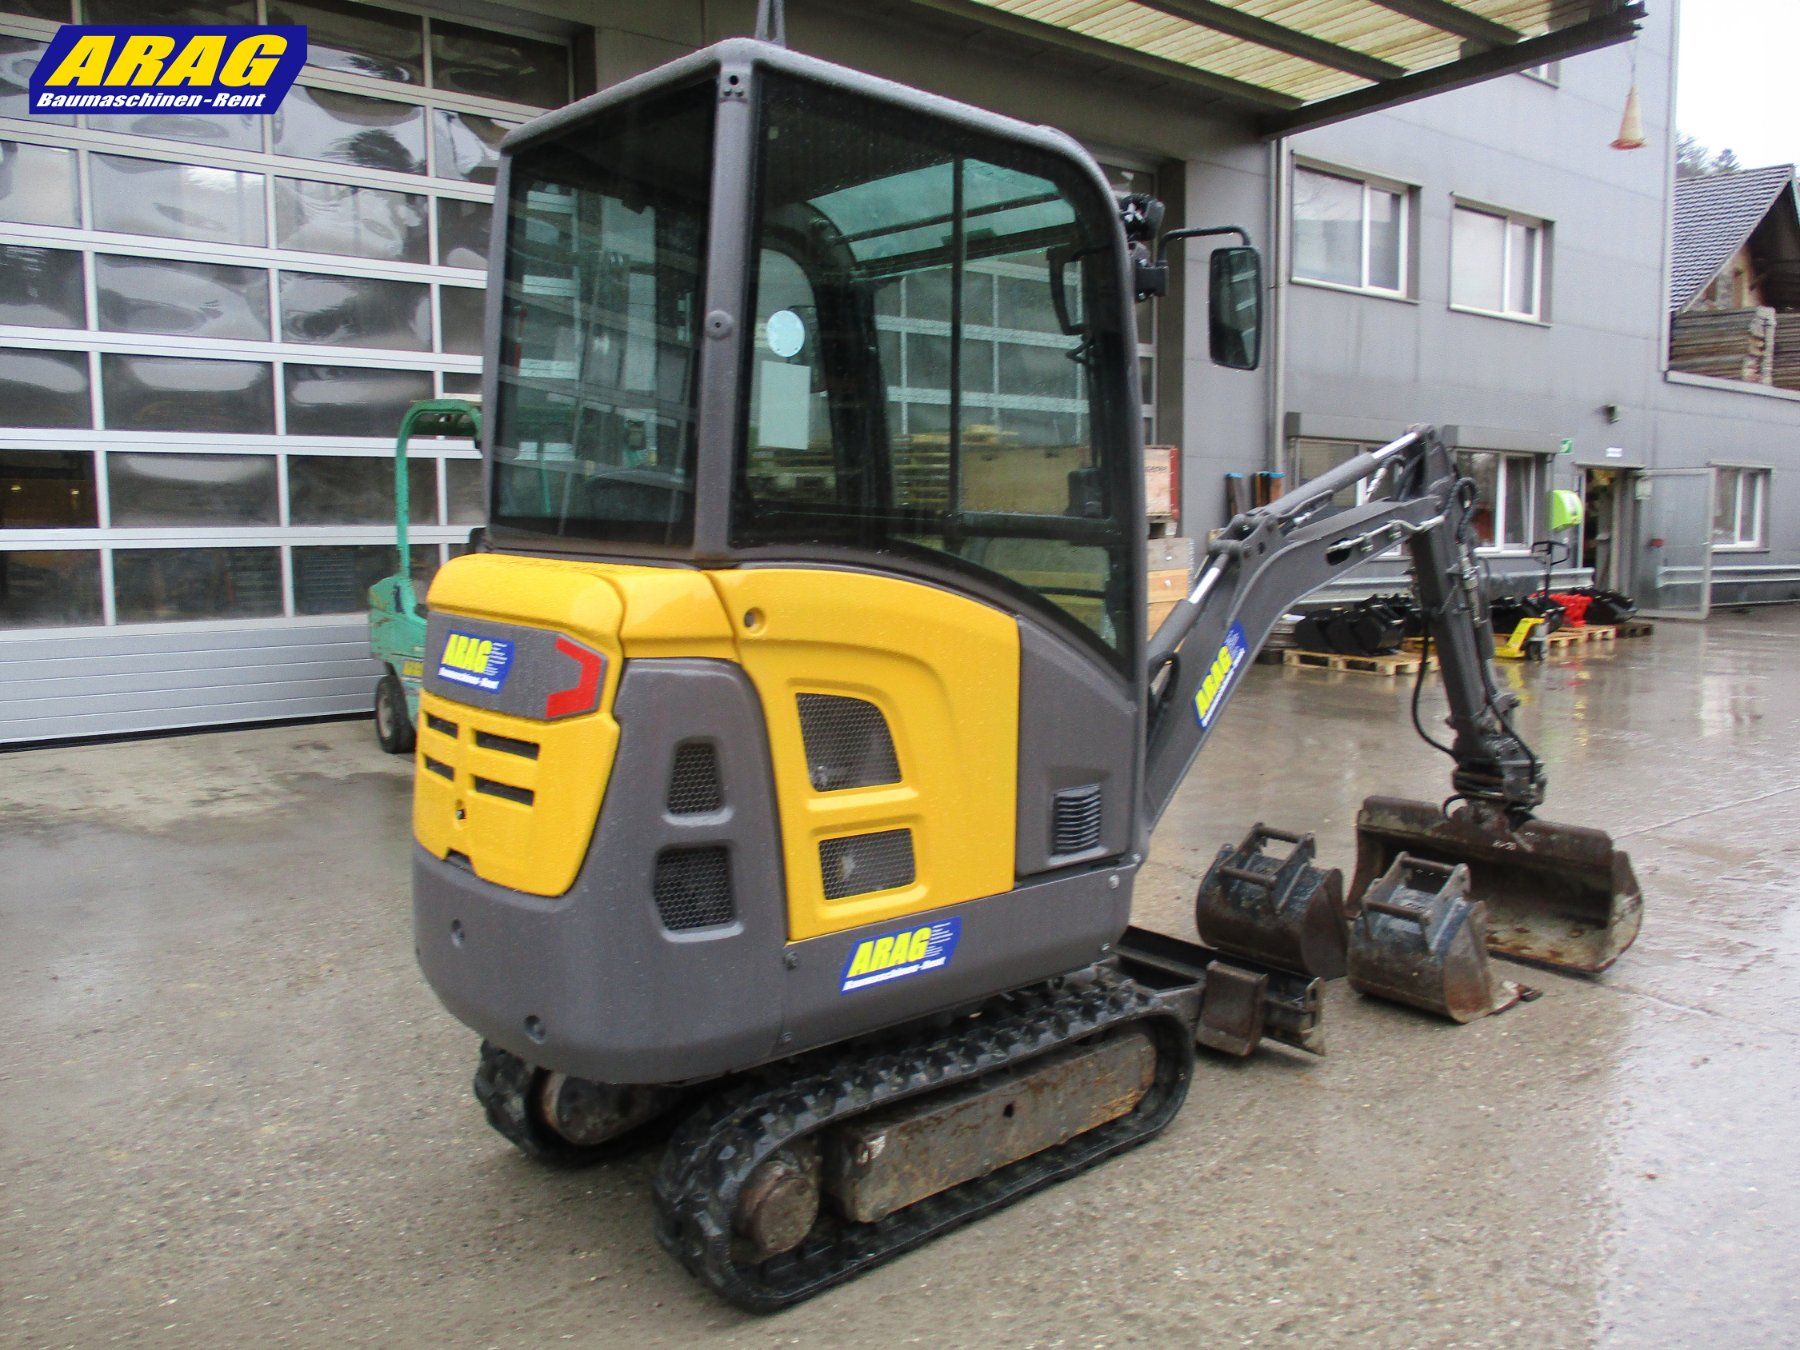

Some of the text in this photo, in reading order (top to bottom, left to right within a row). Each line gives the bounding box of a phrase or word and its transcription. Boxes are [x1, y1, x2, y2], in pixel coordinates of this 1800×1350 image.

[441, 634, 493, 674] ARAG
[1195, 645, 1232, 719] ARAG
[846, 926, 932, 979] ARAG
